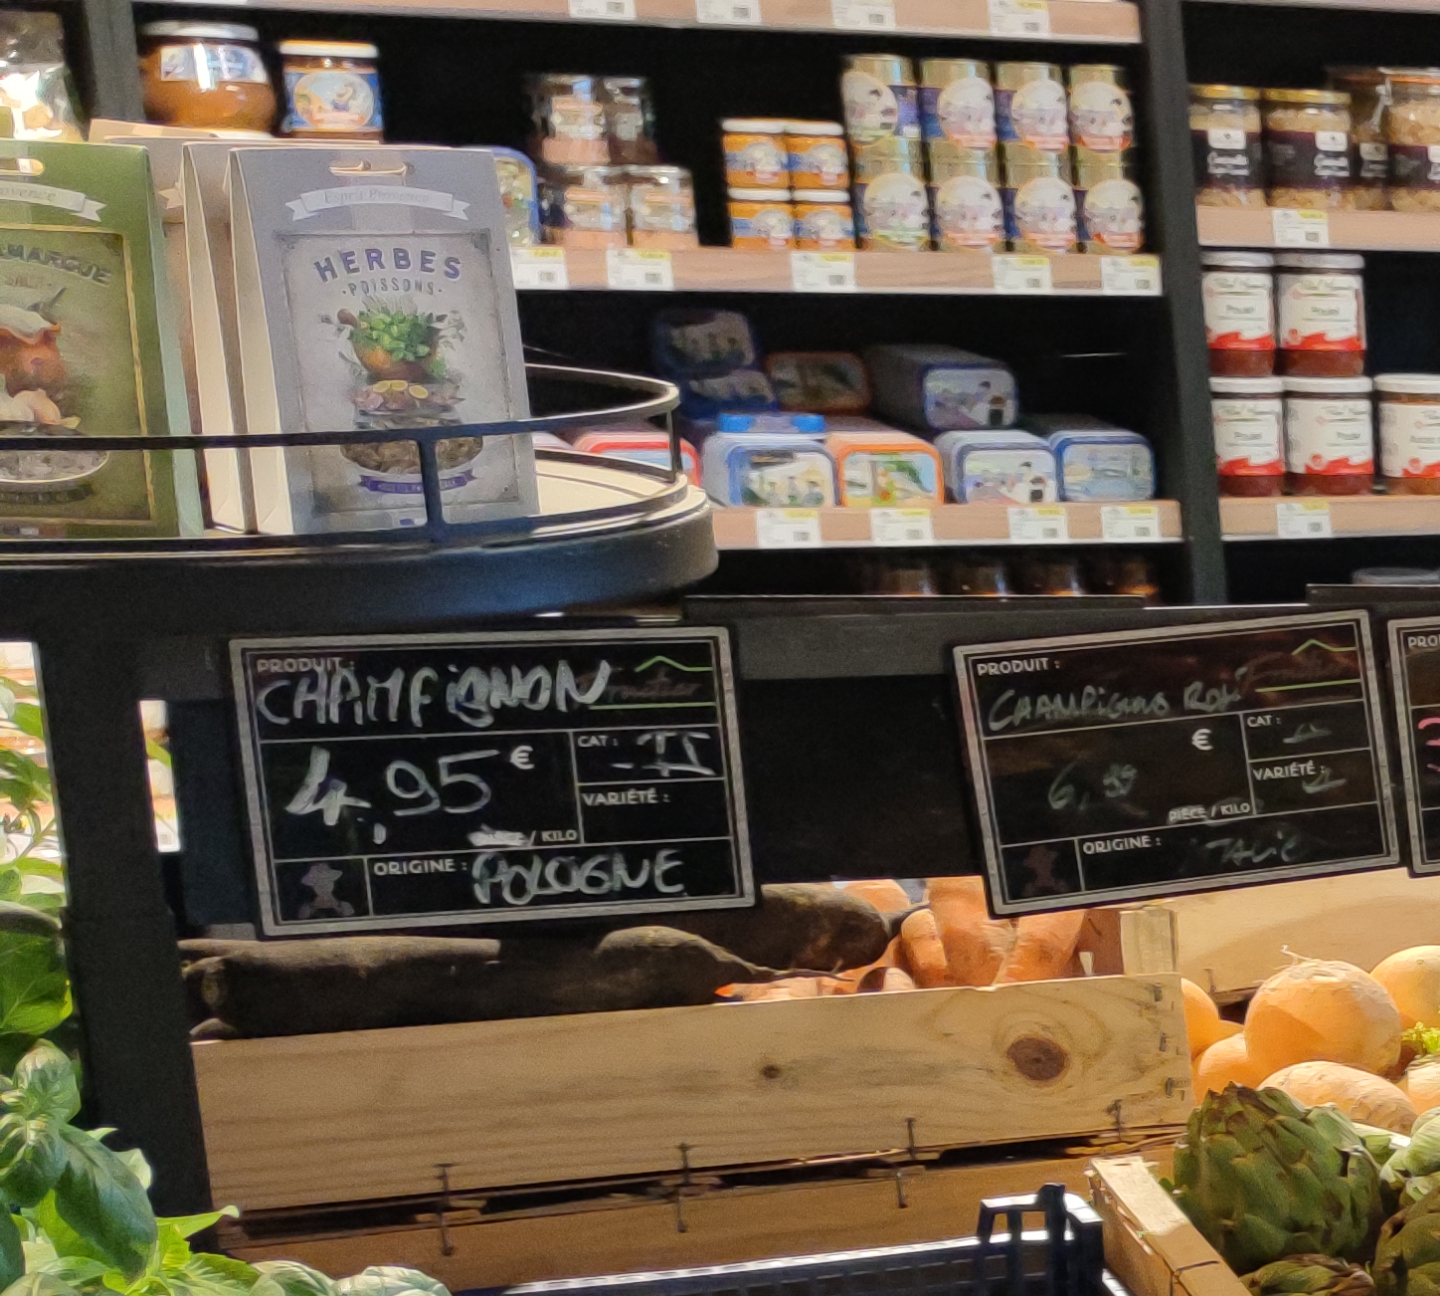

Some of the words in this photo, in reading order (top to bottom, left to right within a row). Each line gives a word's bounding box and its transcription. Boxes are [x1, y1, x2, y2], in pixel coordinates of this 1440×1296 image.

[313, 247, 463, 284] HERBES
[256, 655, 342, 674] PRODUIT
[977, 656, 1050, 676] PRODUIT
[1246, 715, 1273, 728] CAT
[577, 734, 611, 748] CAT
[1191, 728, 1213, 751] €
[510, 745, 535, 770] €
[1252, 759, 1317, 781] VARIÉTÉ
[582, 788, 659, 806] VARIÉTÉ
[1220, 801, 1251, 816] KILO
[540, 828, 578, 842] KILO
[1082, 833, 1152, 855] ORIGINE
[373, 858, 457, 876] ORIGINE
